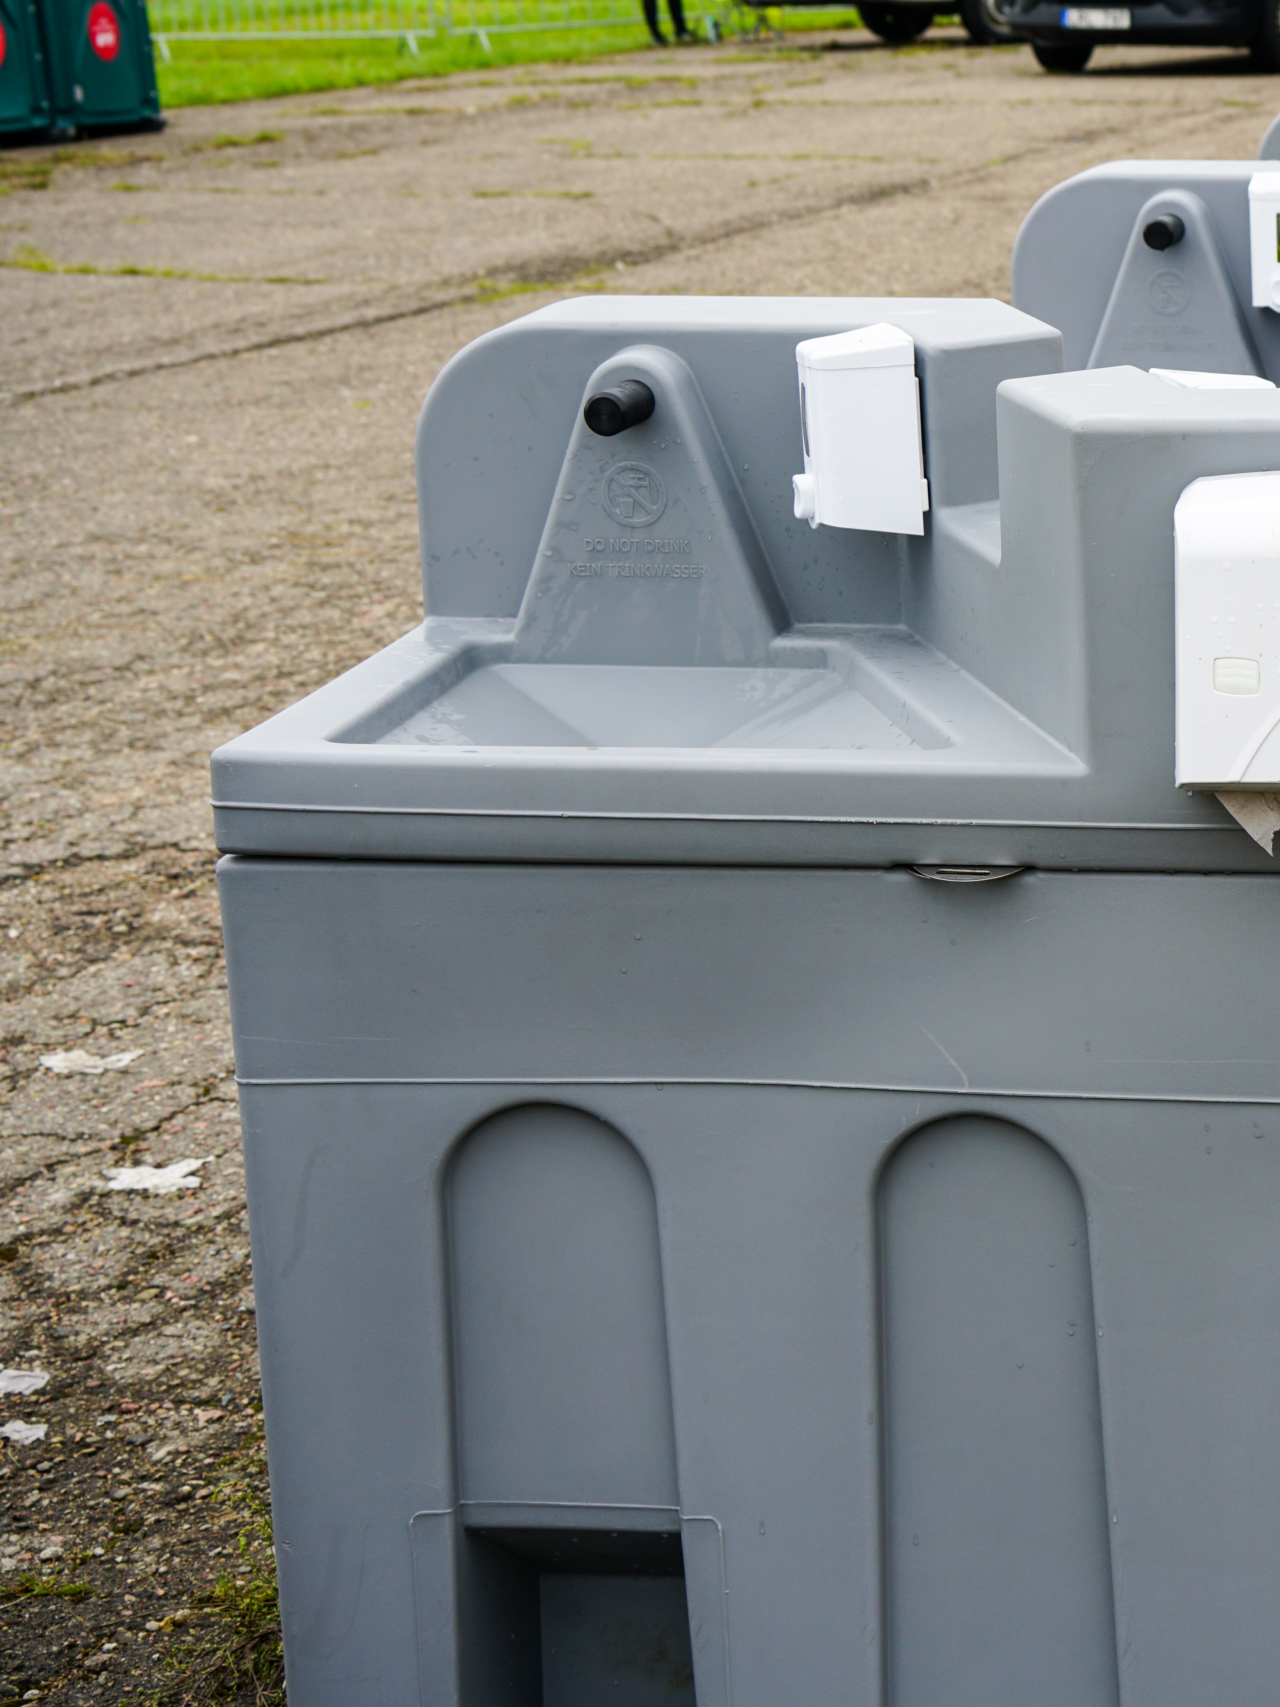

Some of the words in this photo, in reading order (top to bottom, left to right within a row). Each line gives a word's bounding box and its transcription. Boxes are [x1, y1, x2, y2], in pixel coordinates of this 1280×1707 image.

[583, 538, 605, 552] DO
[609, 538, 640, 552] NOT
[644, 539, 690, 554] DRINK
[567, 562, 601, 577] KEIN
[604, 563, 708, 579] TRINKWASSER
